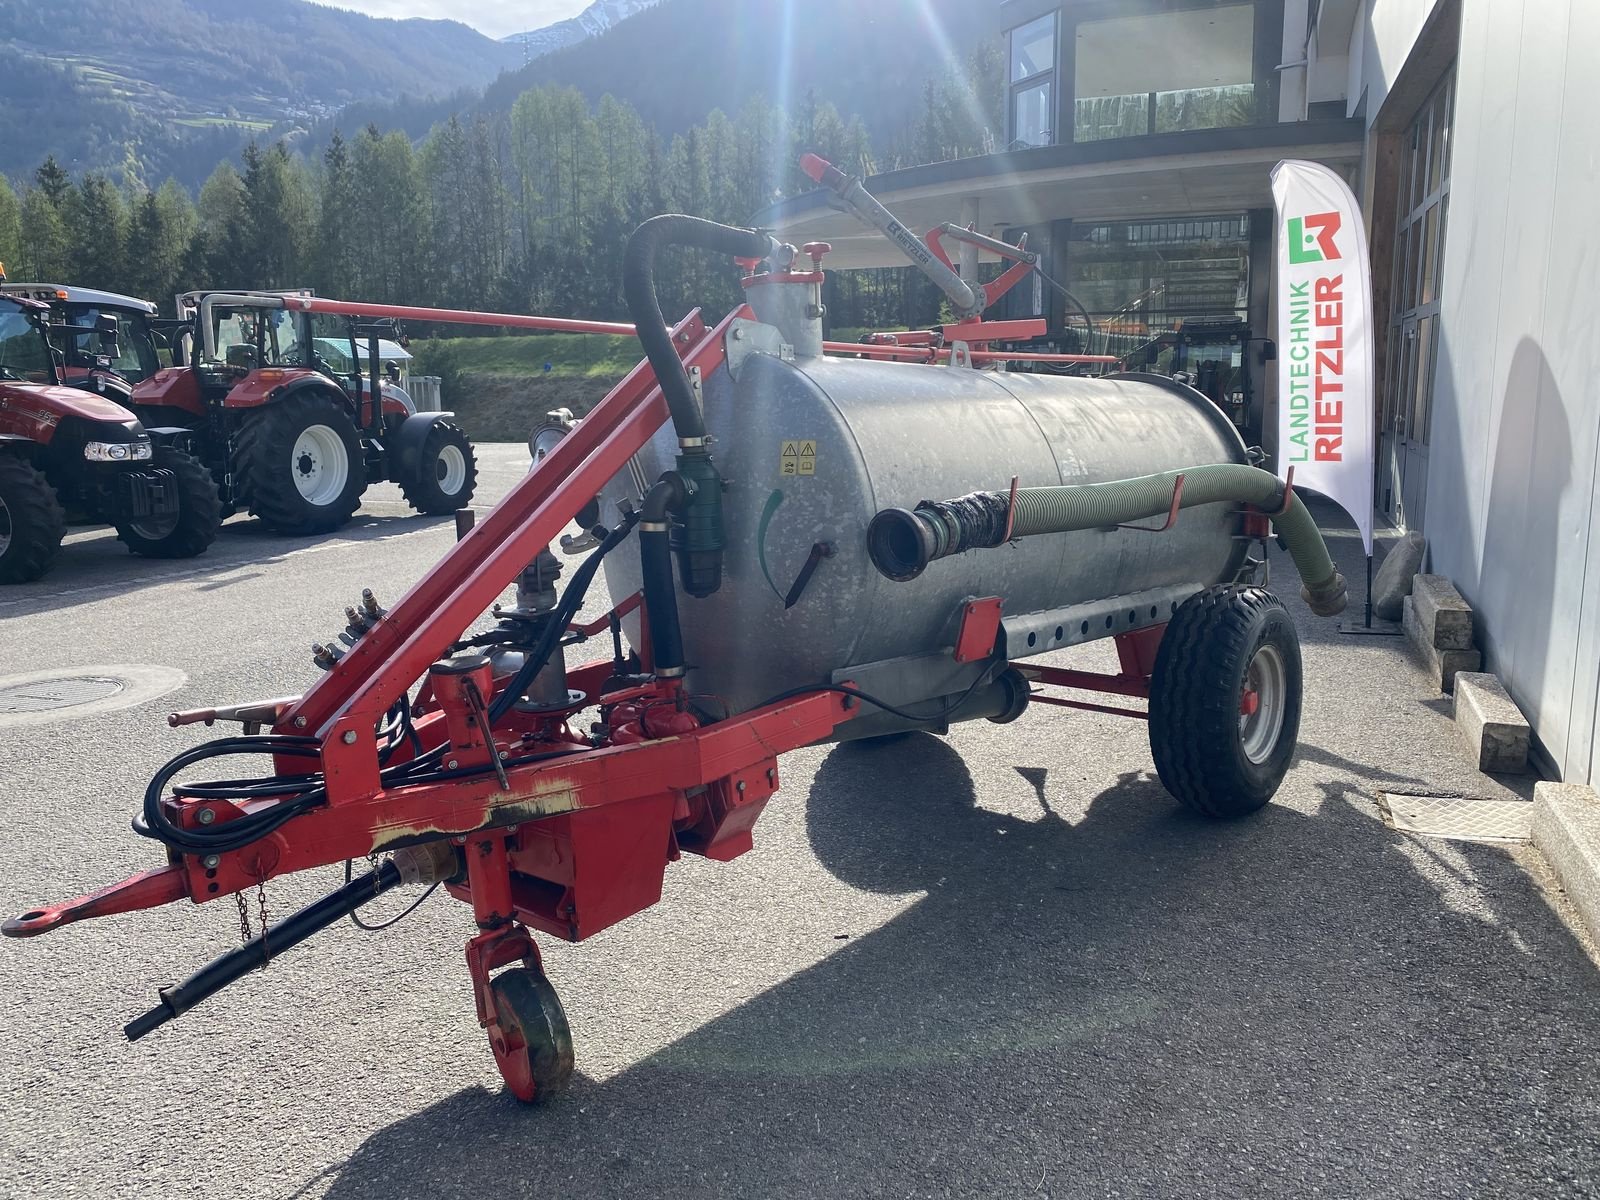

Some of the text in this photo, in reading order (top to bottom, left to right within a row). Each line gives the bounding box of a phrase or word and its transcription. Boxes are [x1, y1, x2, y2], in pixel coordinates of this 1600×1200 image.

[896, 232, 929, 265] RIETZLER
[1289, 280, 1309, 462] LANDTECHNIK
[1314, 273, 1343, 462] RIETZLER
